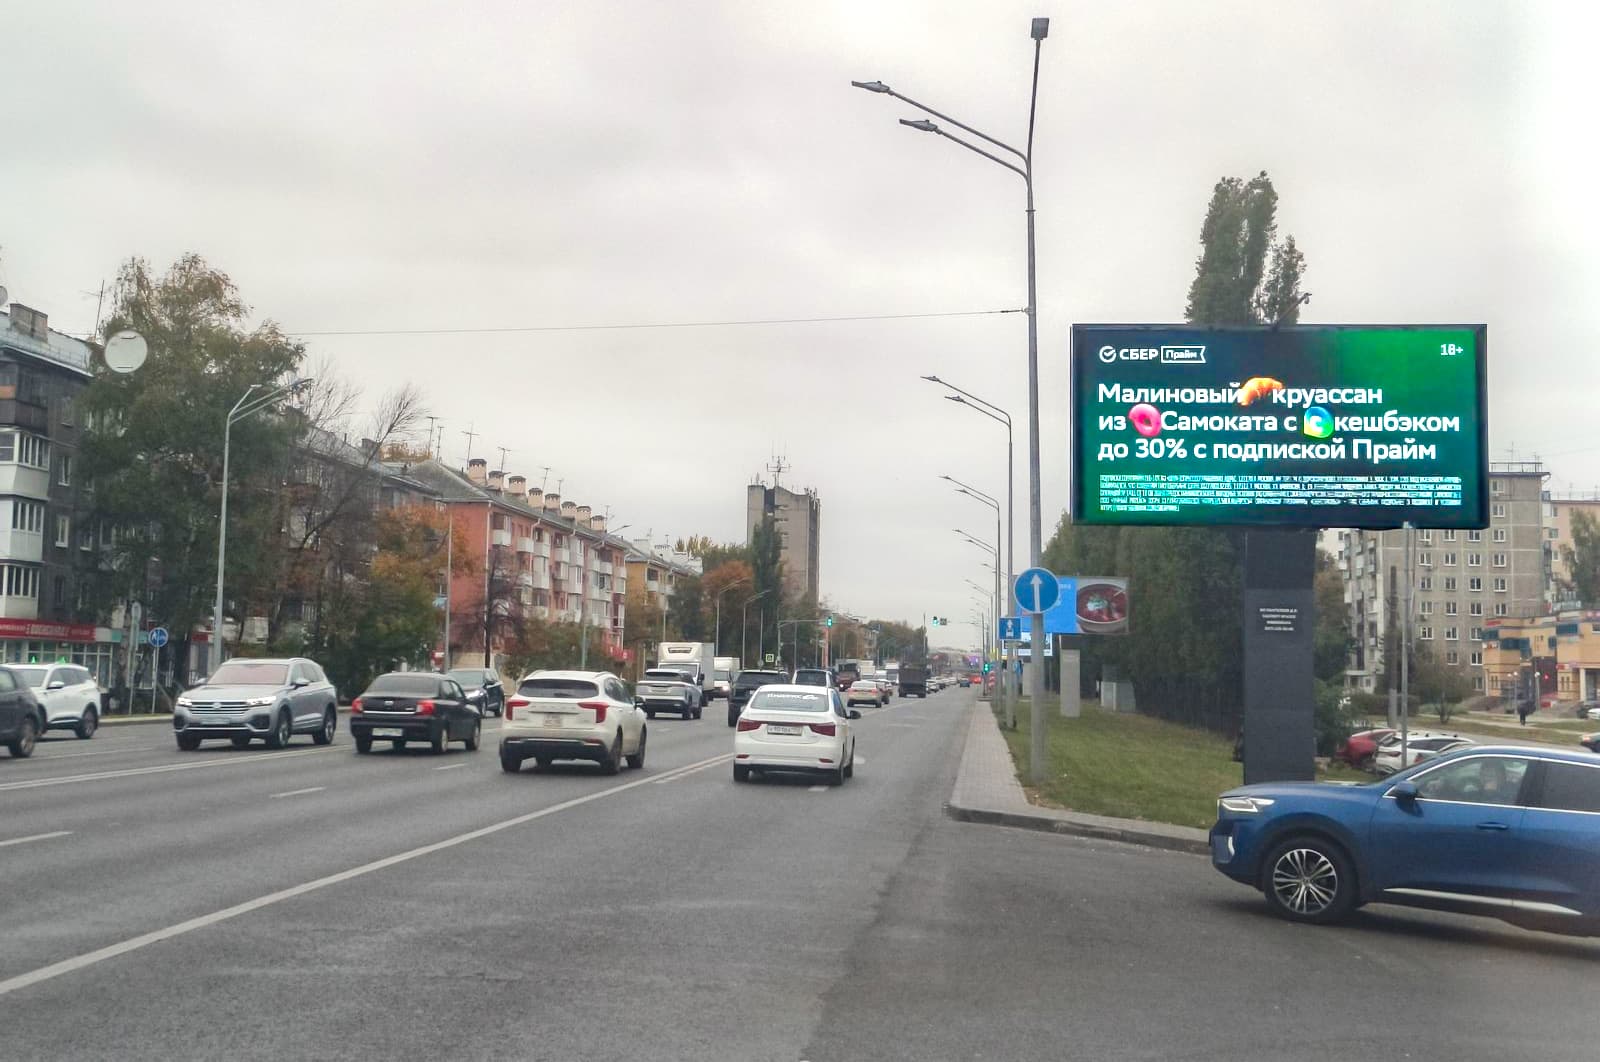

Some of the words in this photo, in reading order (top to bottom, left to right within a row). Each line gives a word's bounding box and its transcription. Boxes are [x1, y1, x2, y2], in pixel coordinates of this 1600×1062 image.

[1119, 348, 1158, 361] СБЕР
[1165, 349, 1198, 360] Прайм
[1440, 343, 1464, 356] 18+
[1098, 382, 1242, 405] Малиновый
[1273, 387, 1383, 409] круассан
[1098, 415, 1127, 431] из
[1161, 411, 1278, 431] Самоката
[1283, 415, 1298, 432] с
[1334, 410, 1460, 431] кешбэком
[1098, 443, 1129, 461] до
[1135, 438, 1188, 459] 30%
[1193, 443, 1207, 459] с
[1213, 438, 1346, 461] подпиской
[1352, 438, 1437, 463] Прайм
